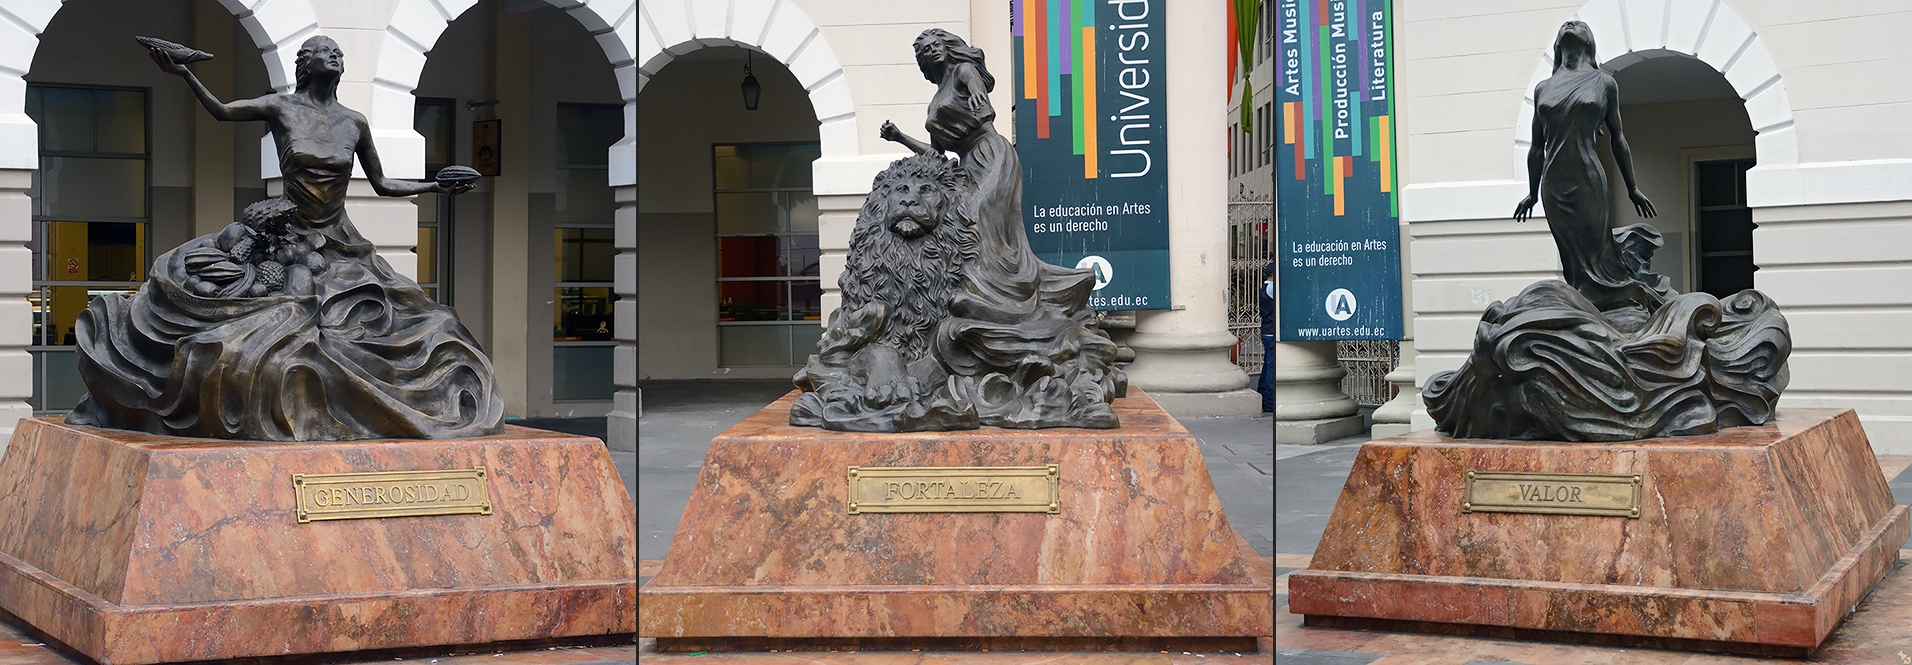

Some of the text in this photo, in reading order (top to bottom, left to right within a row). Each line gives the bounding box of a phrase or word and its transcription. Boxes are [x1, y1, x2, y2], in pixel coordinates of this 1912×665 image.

[1282, 0, 1299, 96] Artes Musi
[1371, 11, 1385, 100] Literatura
[1108, 0, 1151, 178] Universid
[1332, 43, 1349, 139] Producción
[1033, 202, 1151, 218] La educación en Artes
[1033, 219, 1108, 233] es un derecho
[1292, 239, 1387, 253] La educación en Artes
[1292, 254, 1353, 267] es un derecho
[1089, 294, 1148, 307] tes.edu.ec
[1298, 324, 1385, 337] www.uartes.edu.ec
[314, 483, 469, 507] GENEROSIDAD
[885, 480, 1021, 500] FORTALEZA
[1519, 484, 1583, 503] VALOR
